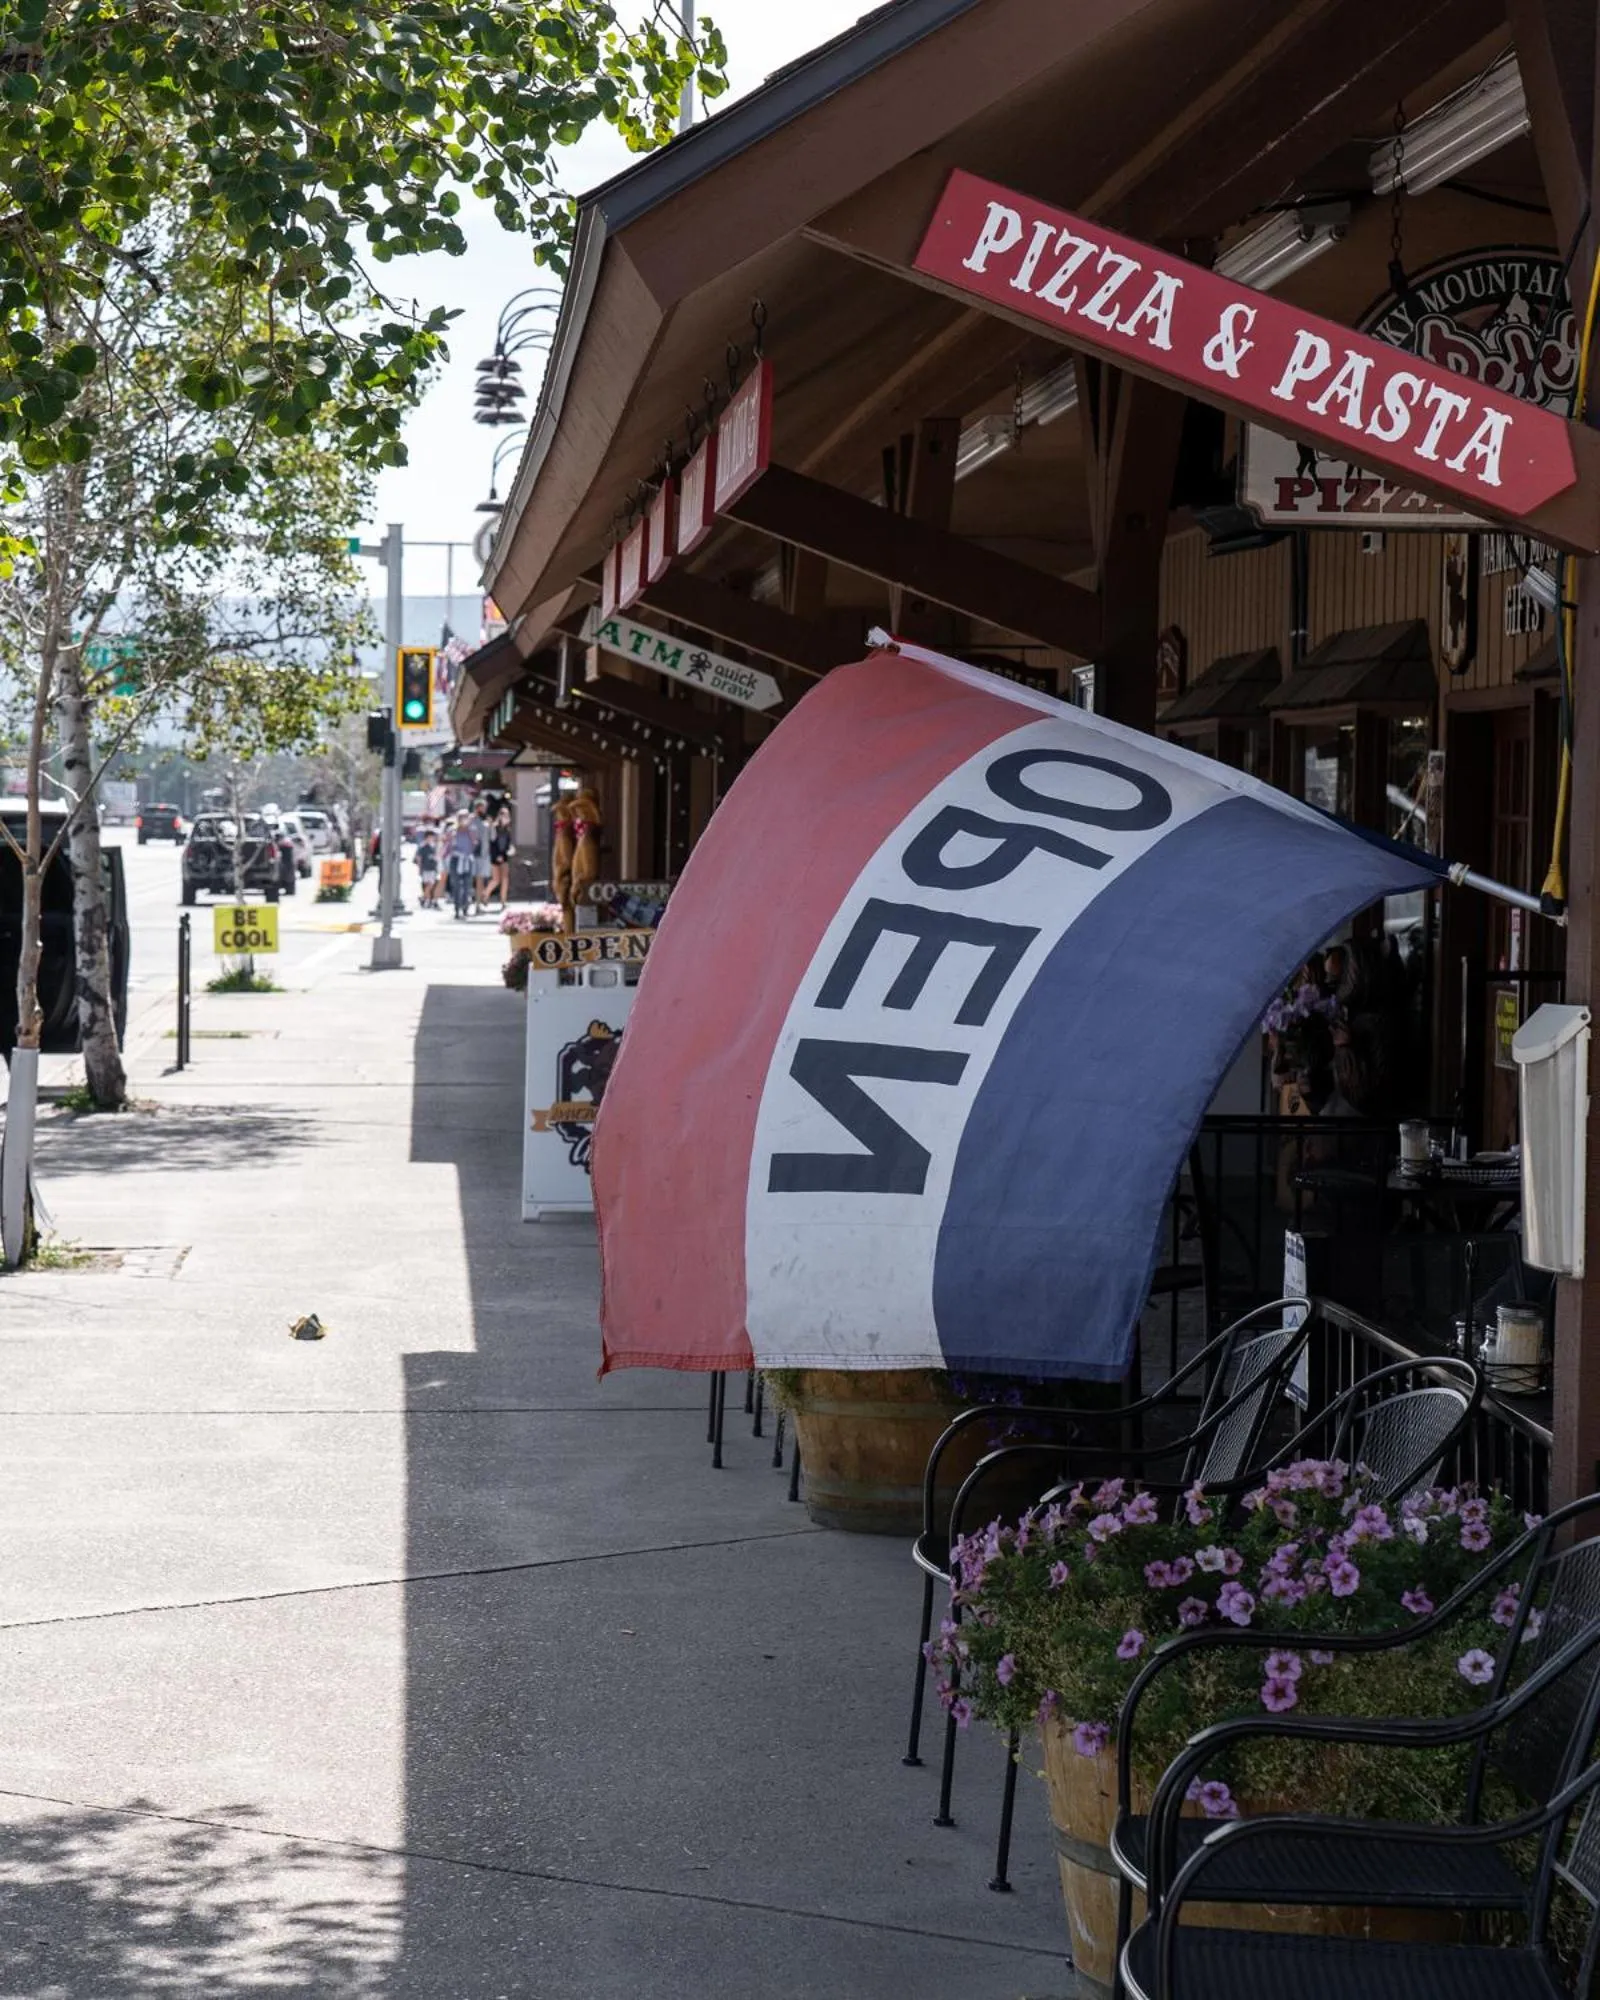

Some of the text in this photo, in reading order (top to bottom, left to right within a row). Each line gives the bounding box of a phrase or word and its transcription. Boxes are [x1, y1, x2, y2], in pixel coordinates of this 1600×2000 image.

[962, 201, 1184, 350] PIZZA
[1202, 303, 1258, 378] &
[1270, 329, 1513, 486] PASTA
[1273, 476, 1465, 514] PIZZ
[594, 620, 684, 671] ATM
[234, 909, 258, 927] BE
[221, 930, 273, 948] COOL
[535, 932, 653, 966] OPEN
